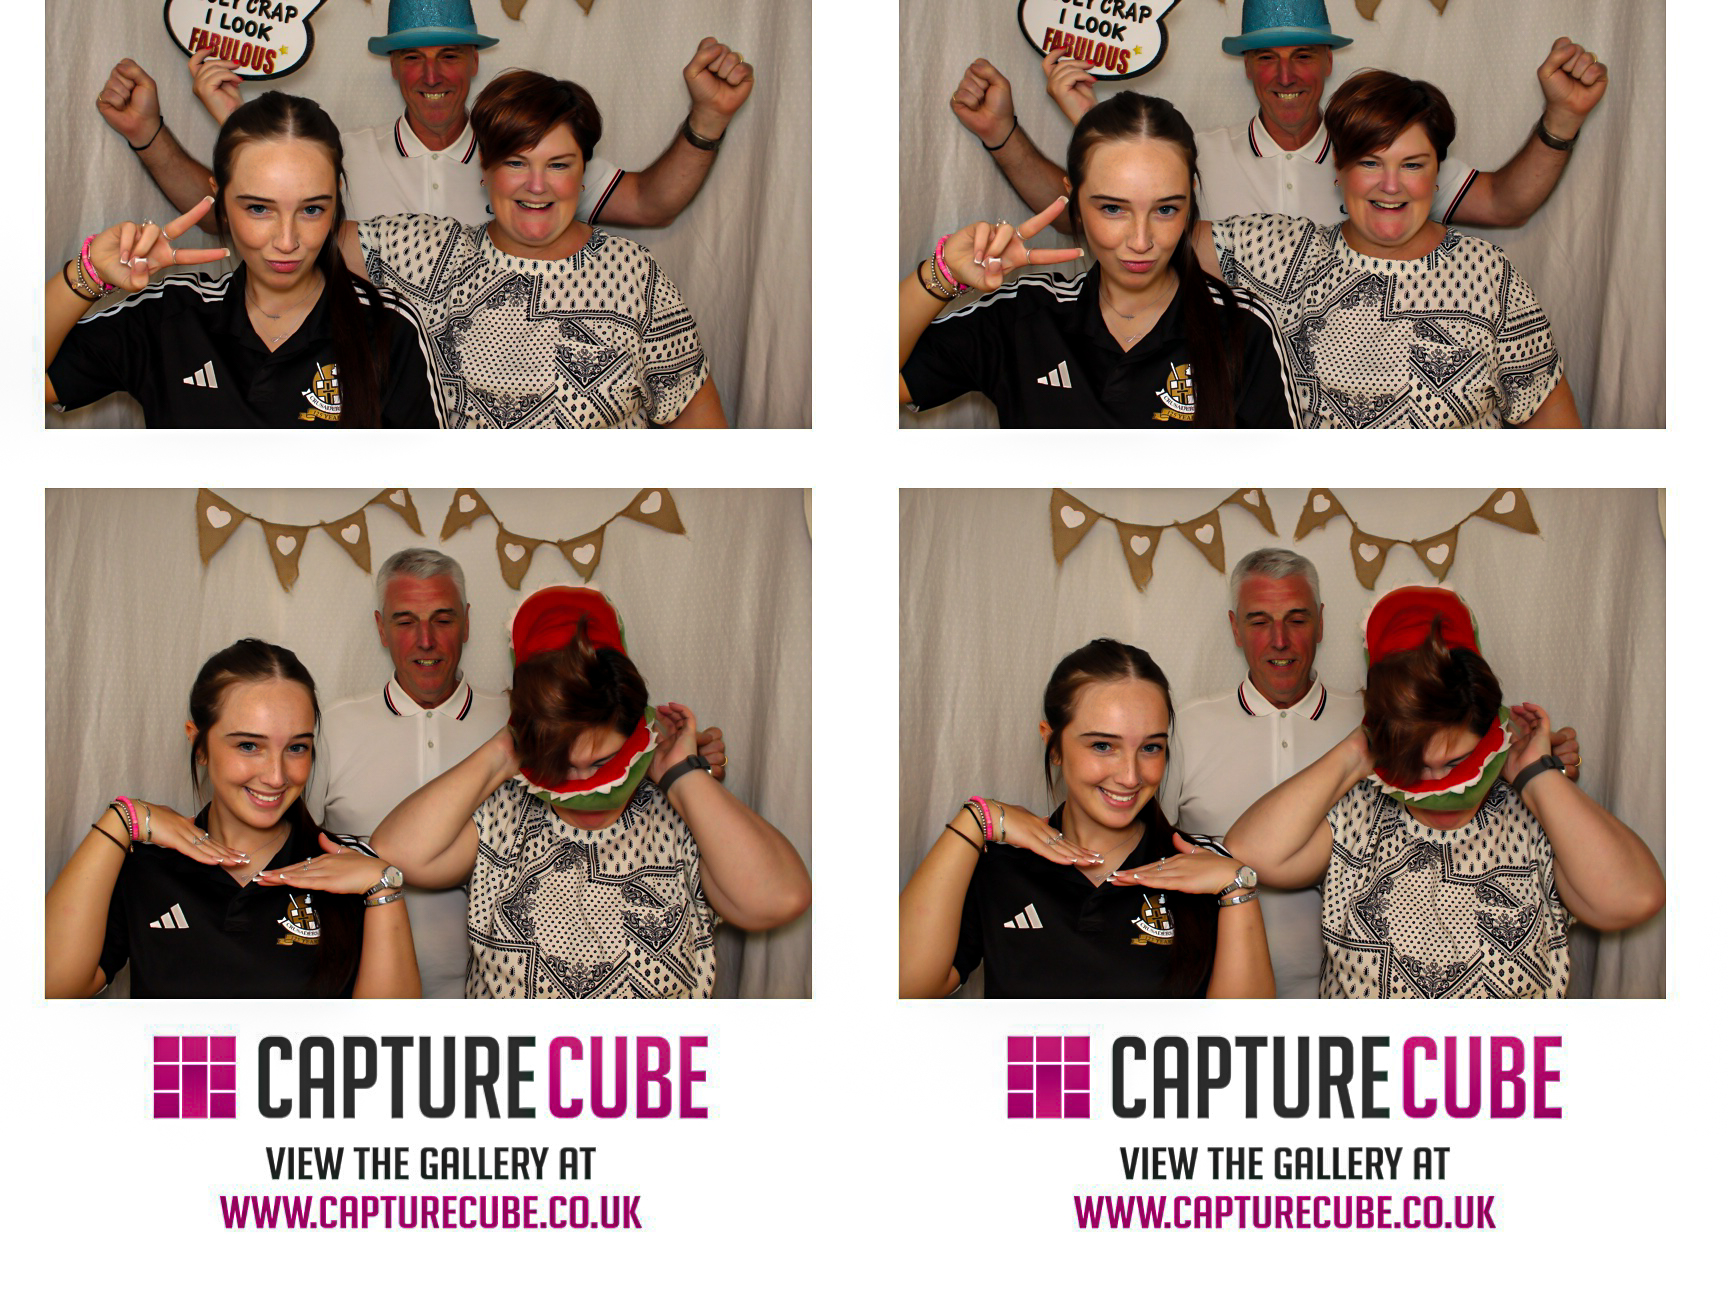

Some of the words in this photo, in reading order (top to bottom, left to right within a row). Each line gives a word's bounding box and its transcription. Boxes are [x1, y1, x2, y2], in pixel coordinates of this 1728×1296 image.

[205, 8, 213, 24] I
[220, 12, 273, 42] LOOK
[1059, 8, 1067, 24] I
[1074, 12, 1127, 42] LOOK
[188, 27, 277, 74] FABULOUS
[1042, 27, 1131, 74] FABULOUS
